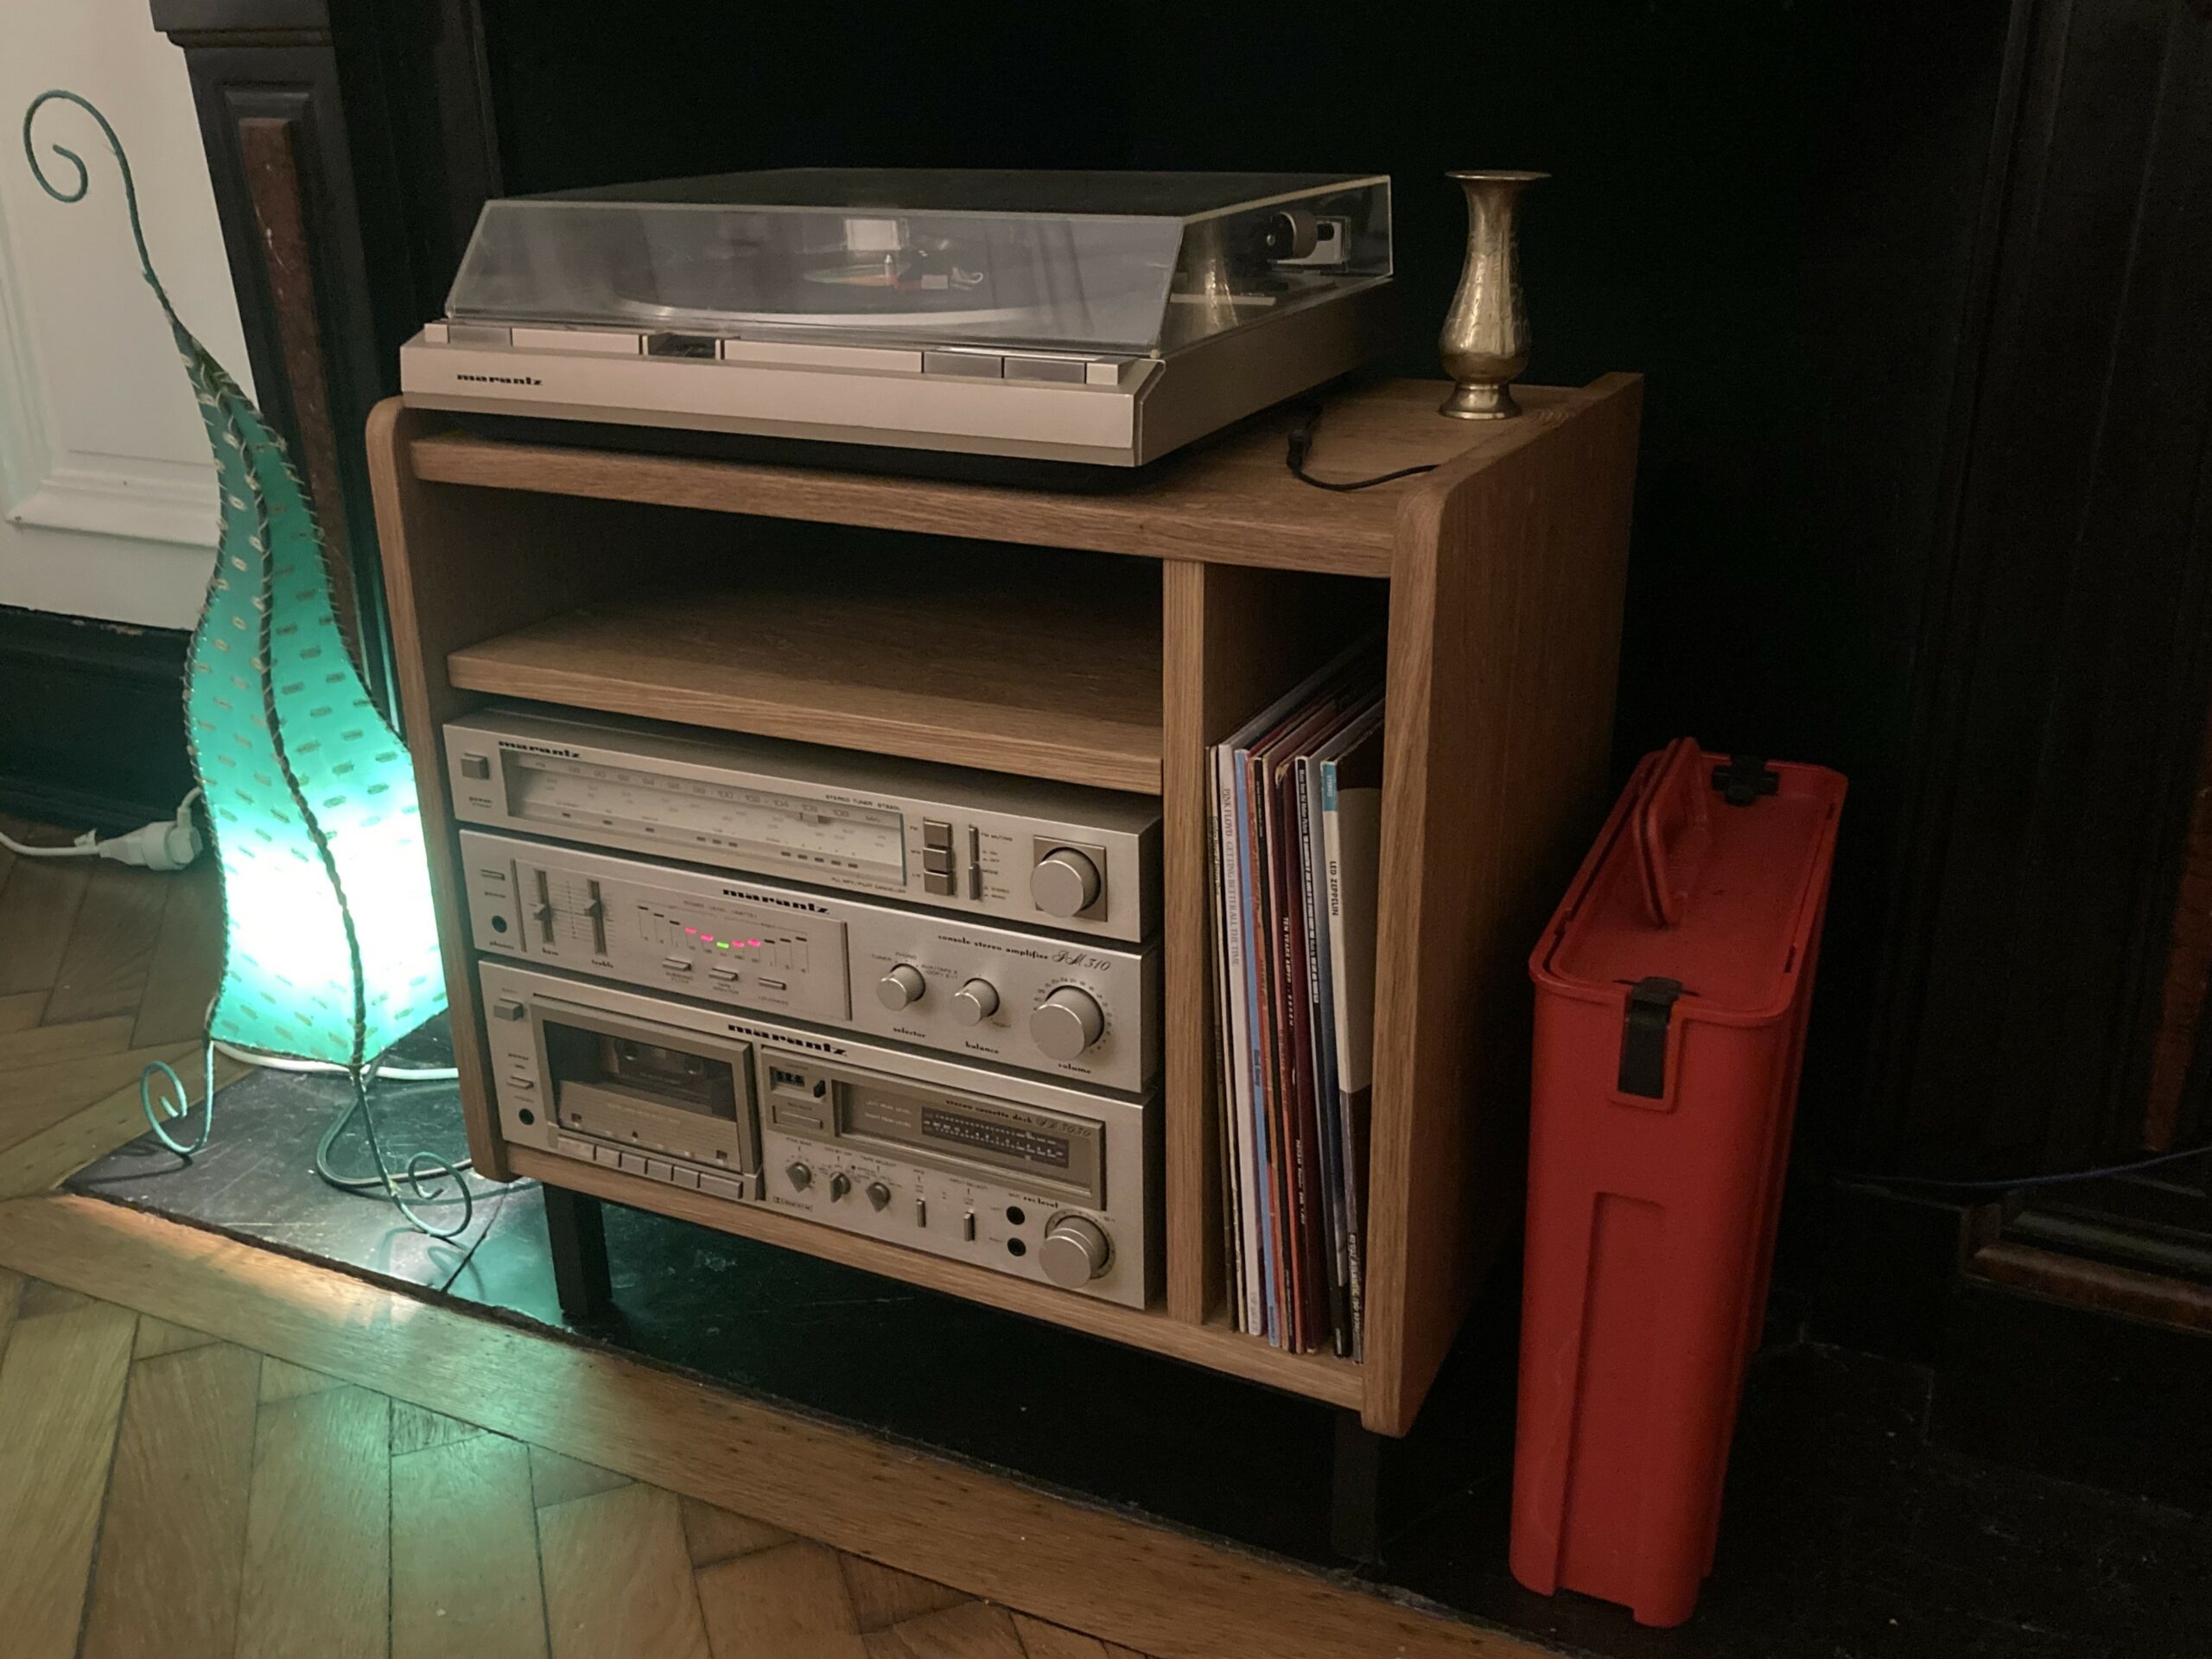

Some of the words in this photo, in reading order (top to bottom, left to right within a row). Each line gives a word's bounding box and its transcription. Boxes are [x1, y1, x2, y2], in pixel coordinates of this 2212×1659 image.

[456, 373, 543, 387] marantz
[498, 741, 581, 759] marantz
[1223, 788, 1233, 808] PINK
[1224, 810, 1234, 837] FLOYD
[722, 888, 830, 914] marantz
[938, 933, 971, 945] console
[974, 939, 1002, 951] stereo
[1005, 945, 1049, 961] amplifier
[1230, 946, 1240, 967] TIME
[728, 1024, 849, 1057] marantz
[965, 1040, 1000, 1054] balance
[1058, 1063, 1091, 1074] volume
